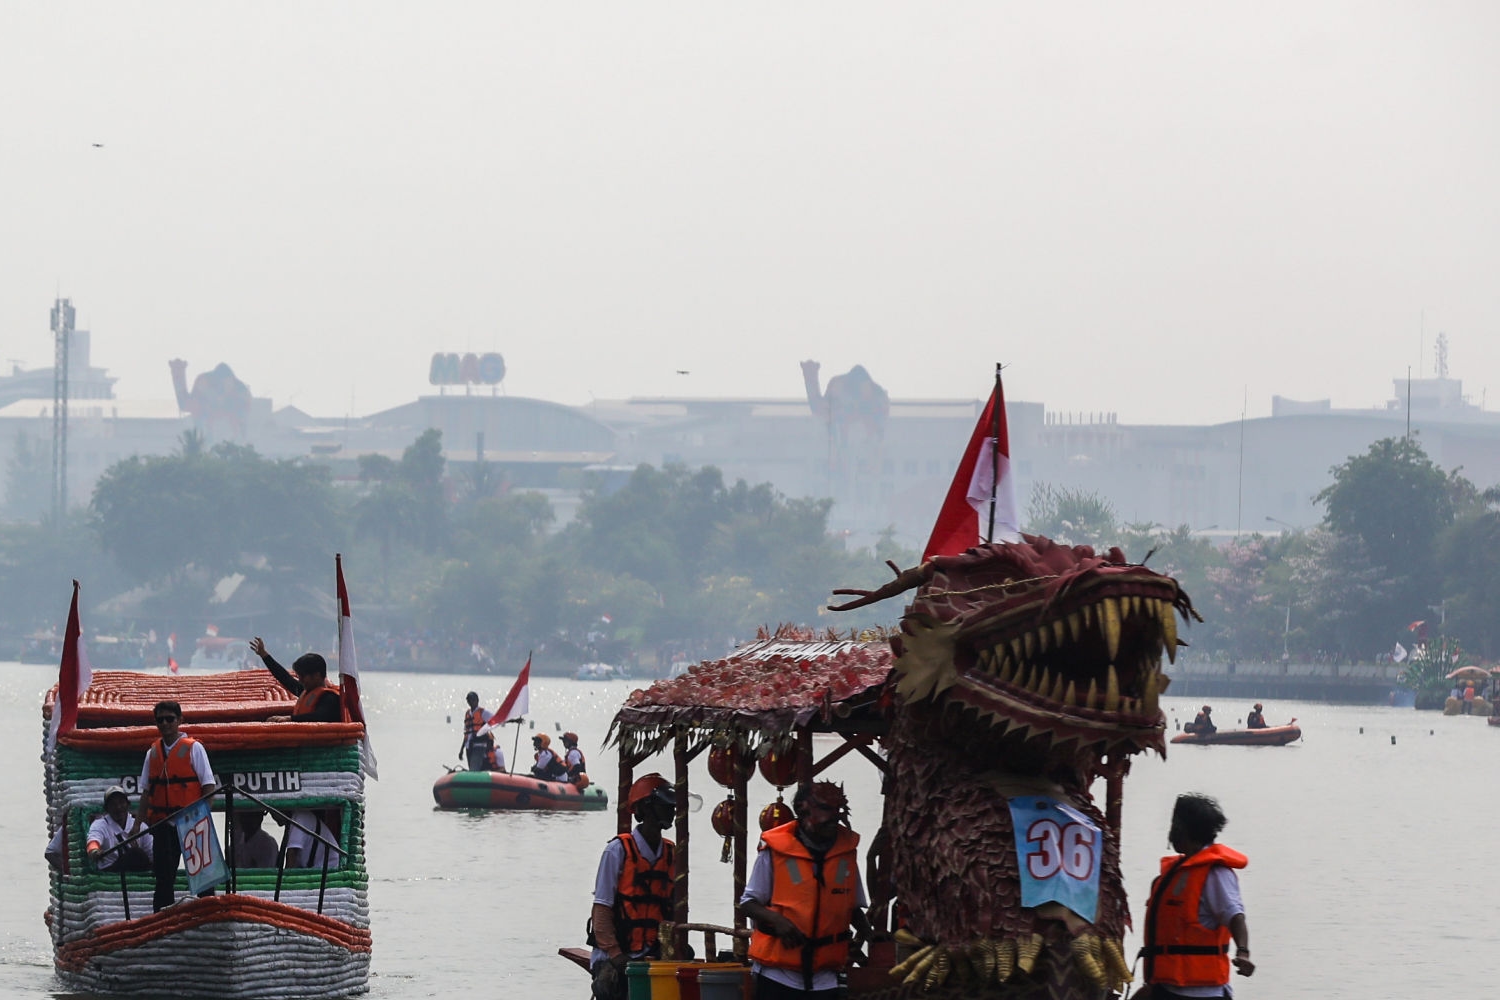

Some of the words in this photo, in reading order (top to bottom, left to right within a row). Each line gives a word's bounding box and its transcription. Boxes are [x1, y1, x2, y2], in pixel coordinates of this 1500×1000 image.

[233, 771, 301, 792] PUTIH
[184, 816, 213, 877] 37
[1026, 818, 1096, 881] 36
